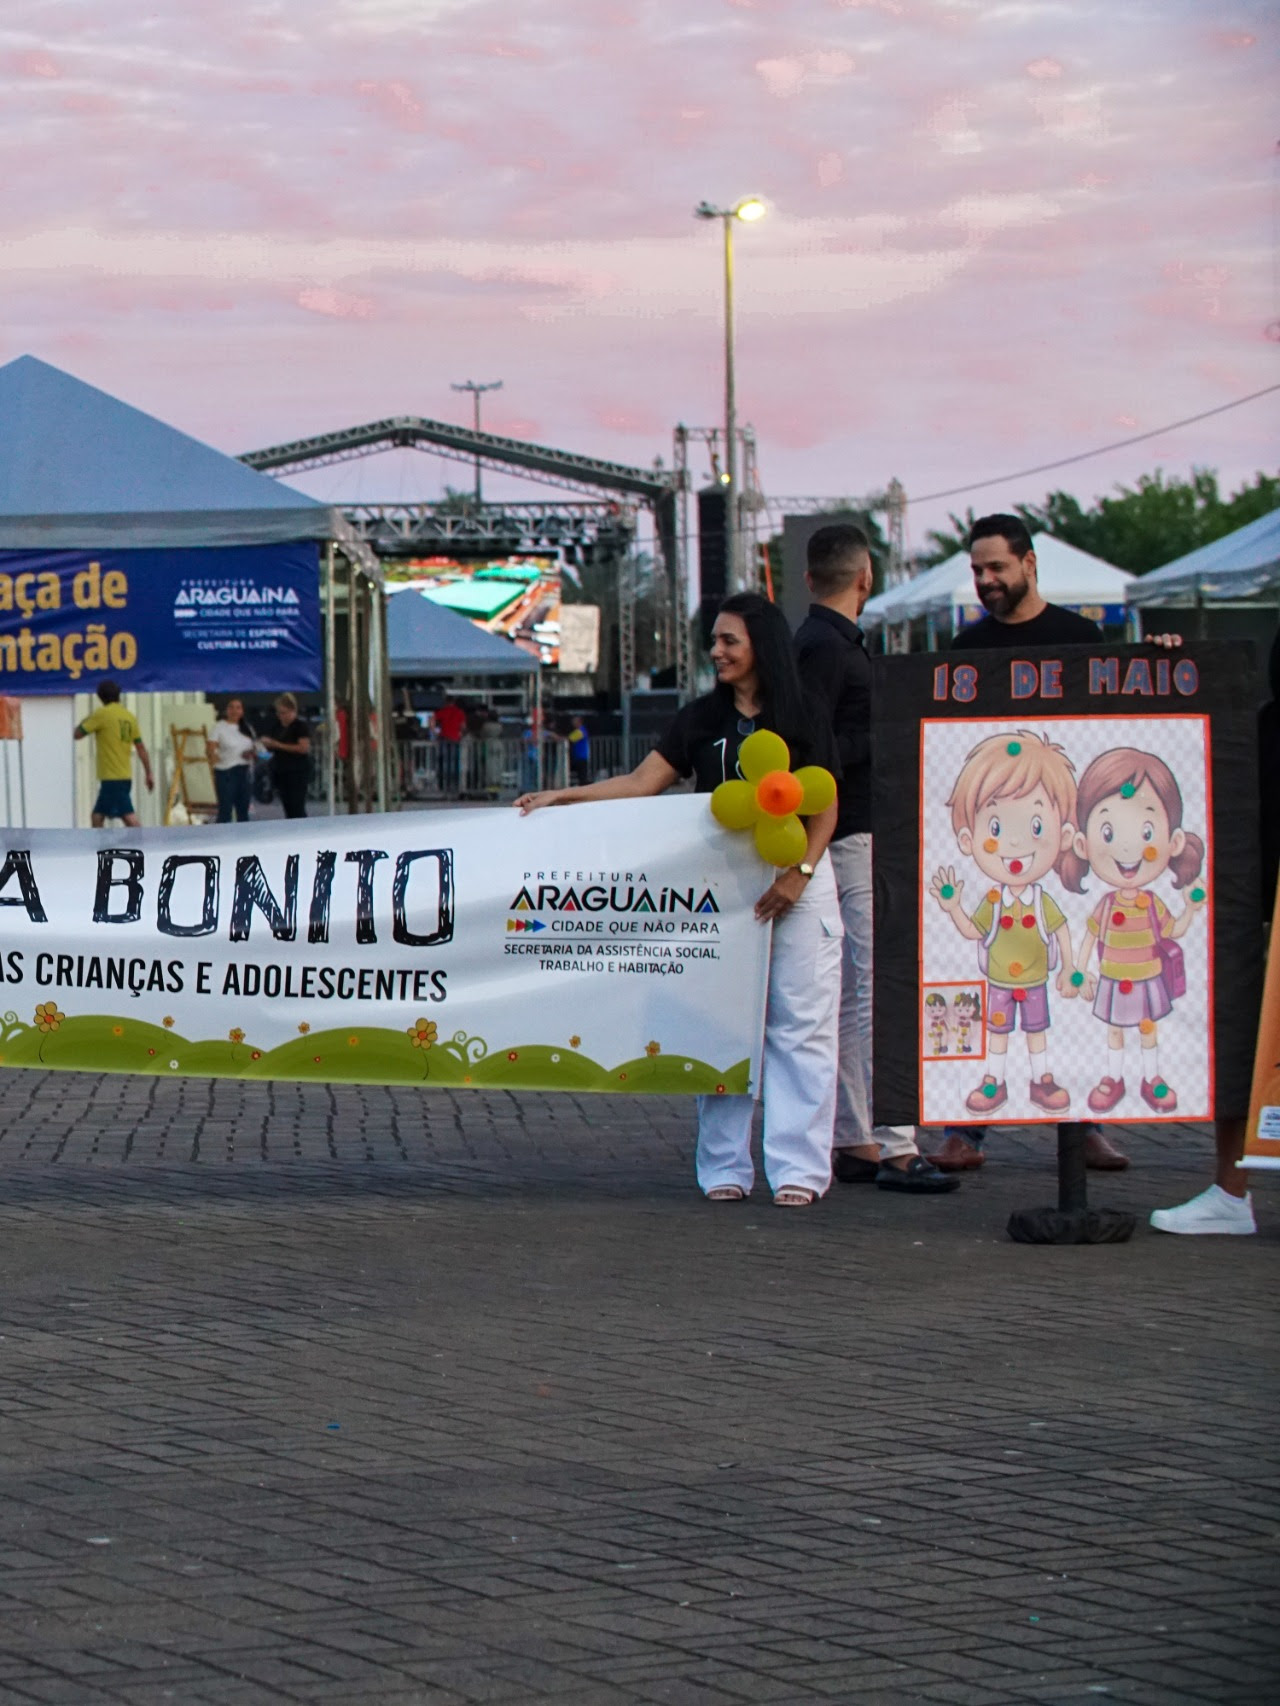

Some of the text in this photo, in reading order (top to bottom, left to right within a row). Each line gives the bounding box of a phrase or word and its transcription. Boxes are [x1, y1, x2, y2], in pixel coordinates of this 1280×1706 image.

[73, 562, 128, 608] de
[933, 657, 1199, 702] 18 DE MAIO
[523, 871, 648, 882] PREFEITURA
[92, 848, 455, 946] BONITO
[551, 919, 720, 935] CIDADE QUE NÃO PARA
[504, 944, 720, 960] SECRETARIA DA ASSISTÊNCIA SOCIAL,
[539, 959, 684, 976] TRABALHO E HABITAÇÃO
[35, 953, 184, 997] CRIANÇAS
[196, 962, 213, 994] E
[222, 963, 448, 1002] ADOLESCENTES
